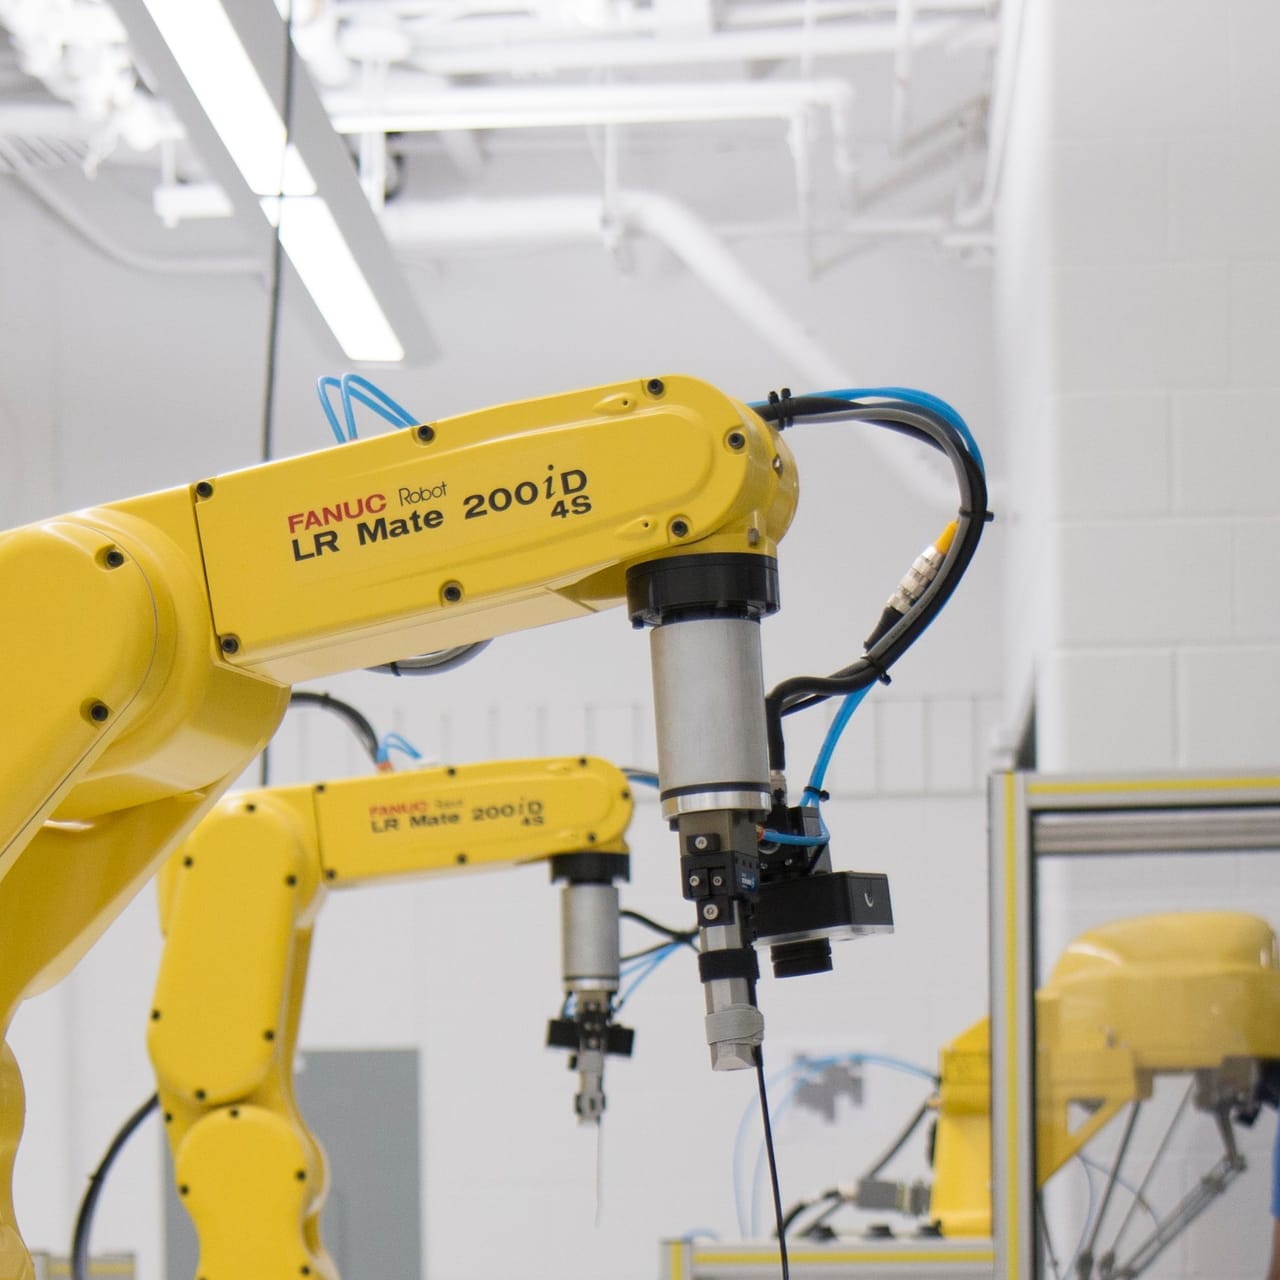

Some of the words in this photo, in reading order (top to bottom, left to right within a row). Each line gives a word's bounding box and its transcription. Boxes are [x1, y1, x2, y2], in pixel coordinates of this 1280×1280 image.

[288, 493, 387, 533] FANUC
[398, 481, 448, 506] Robot
[292, 530, 340, 561] LR
[358, 508, 444, 545] Mate
[463, 464, 588, 519] 200iD
[551, 496, 592, 519] 4S
[371, 818, 399, 833] LR
[410, 812, 460, 828] Mate
